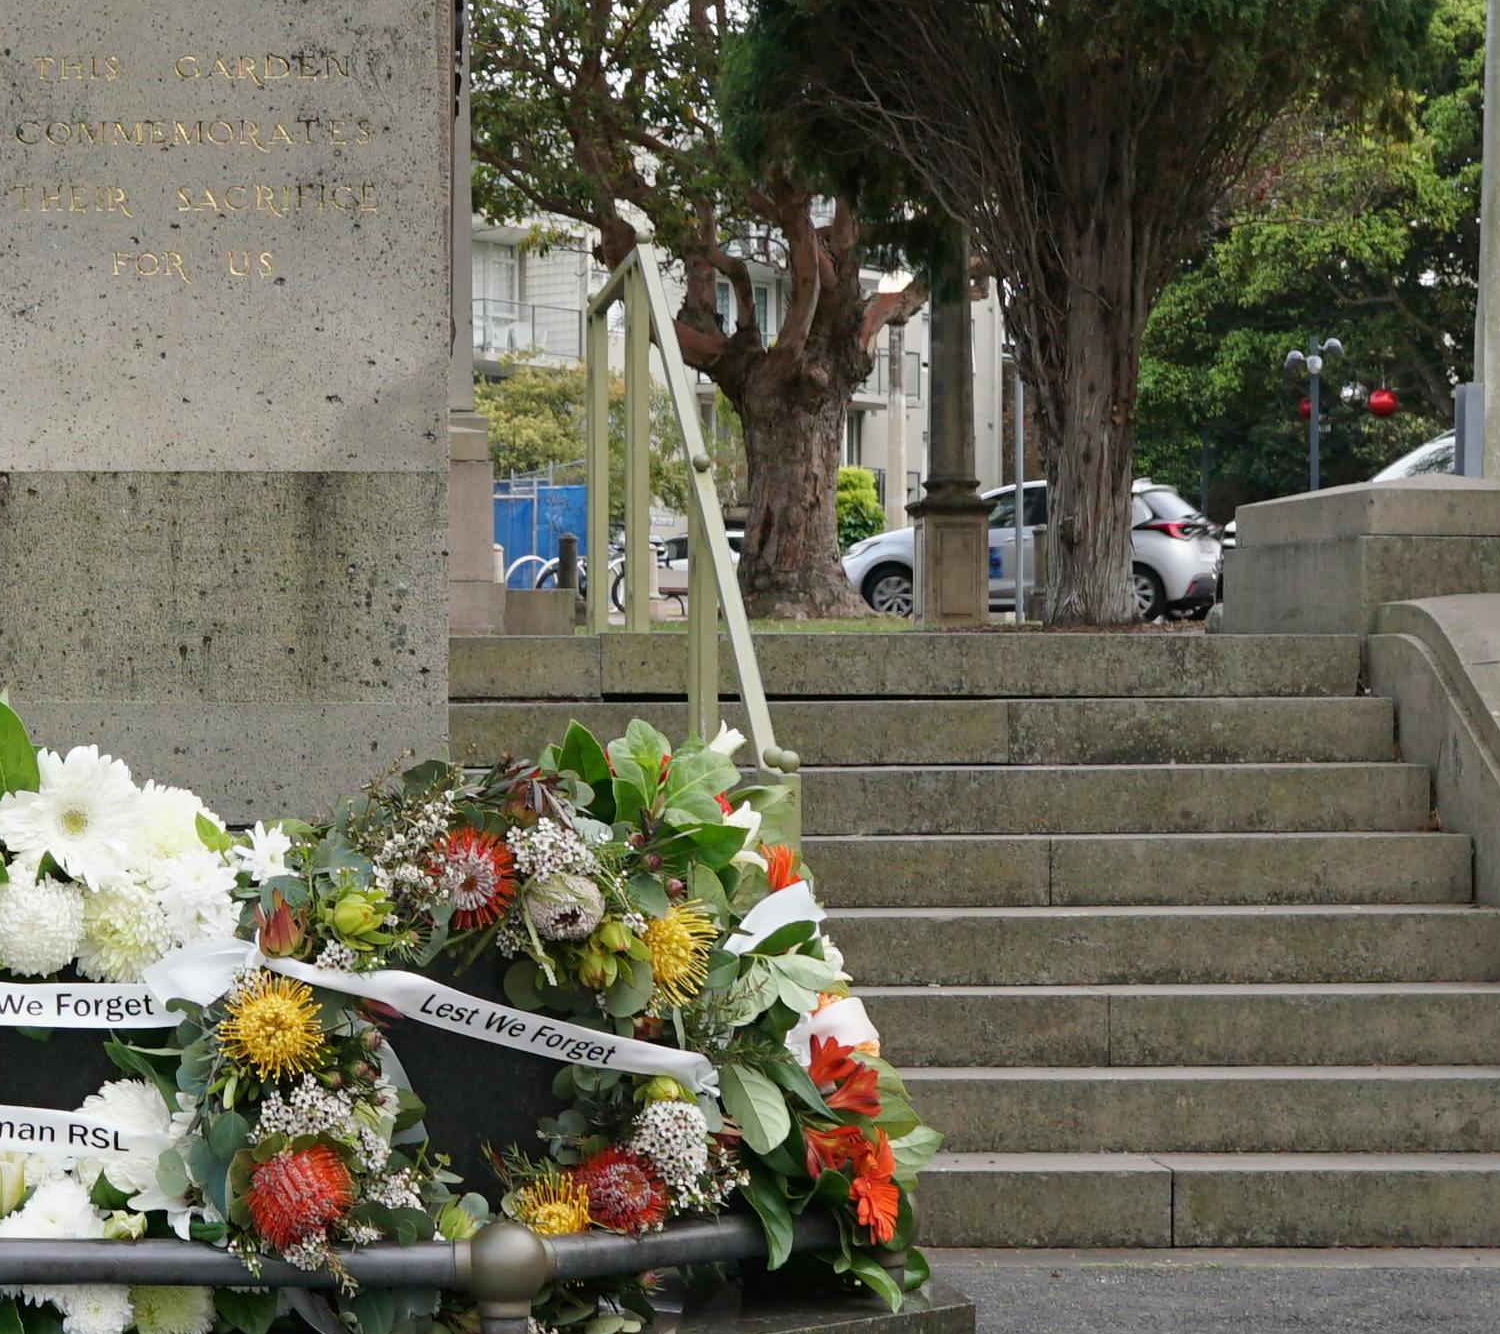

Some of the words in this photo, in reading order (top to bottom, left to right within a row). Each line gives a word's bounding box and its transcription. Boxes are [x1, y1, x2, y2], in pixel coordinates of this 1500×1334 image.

[34, 55, 119, 82] THIS
[175, 54, 351, 87] GARDEN
[15, 118, 372, 154] COMMEMORATES
[14, 184, 134, 219] THEIR
[177, 183, 381, 218] SACRIFICE
[111, 250, 192, 285] FOR
[228, 250, 276, 277] US
[56, 993, 155, 1022] Forget
[419, 993, 480, 1026] Lest
[484, 1011, 526, 1038] We
[530, 1025, 617, 1065] Forget
[68, 1123, 130, 1152] RSL
